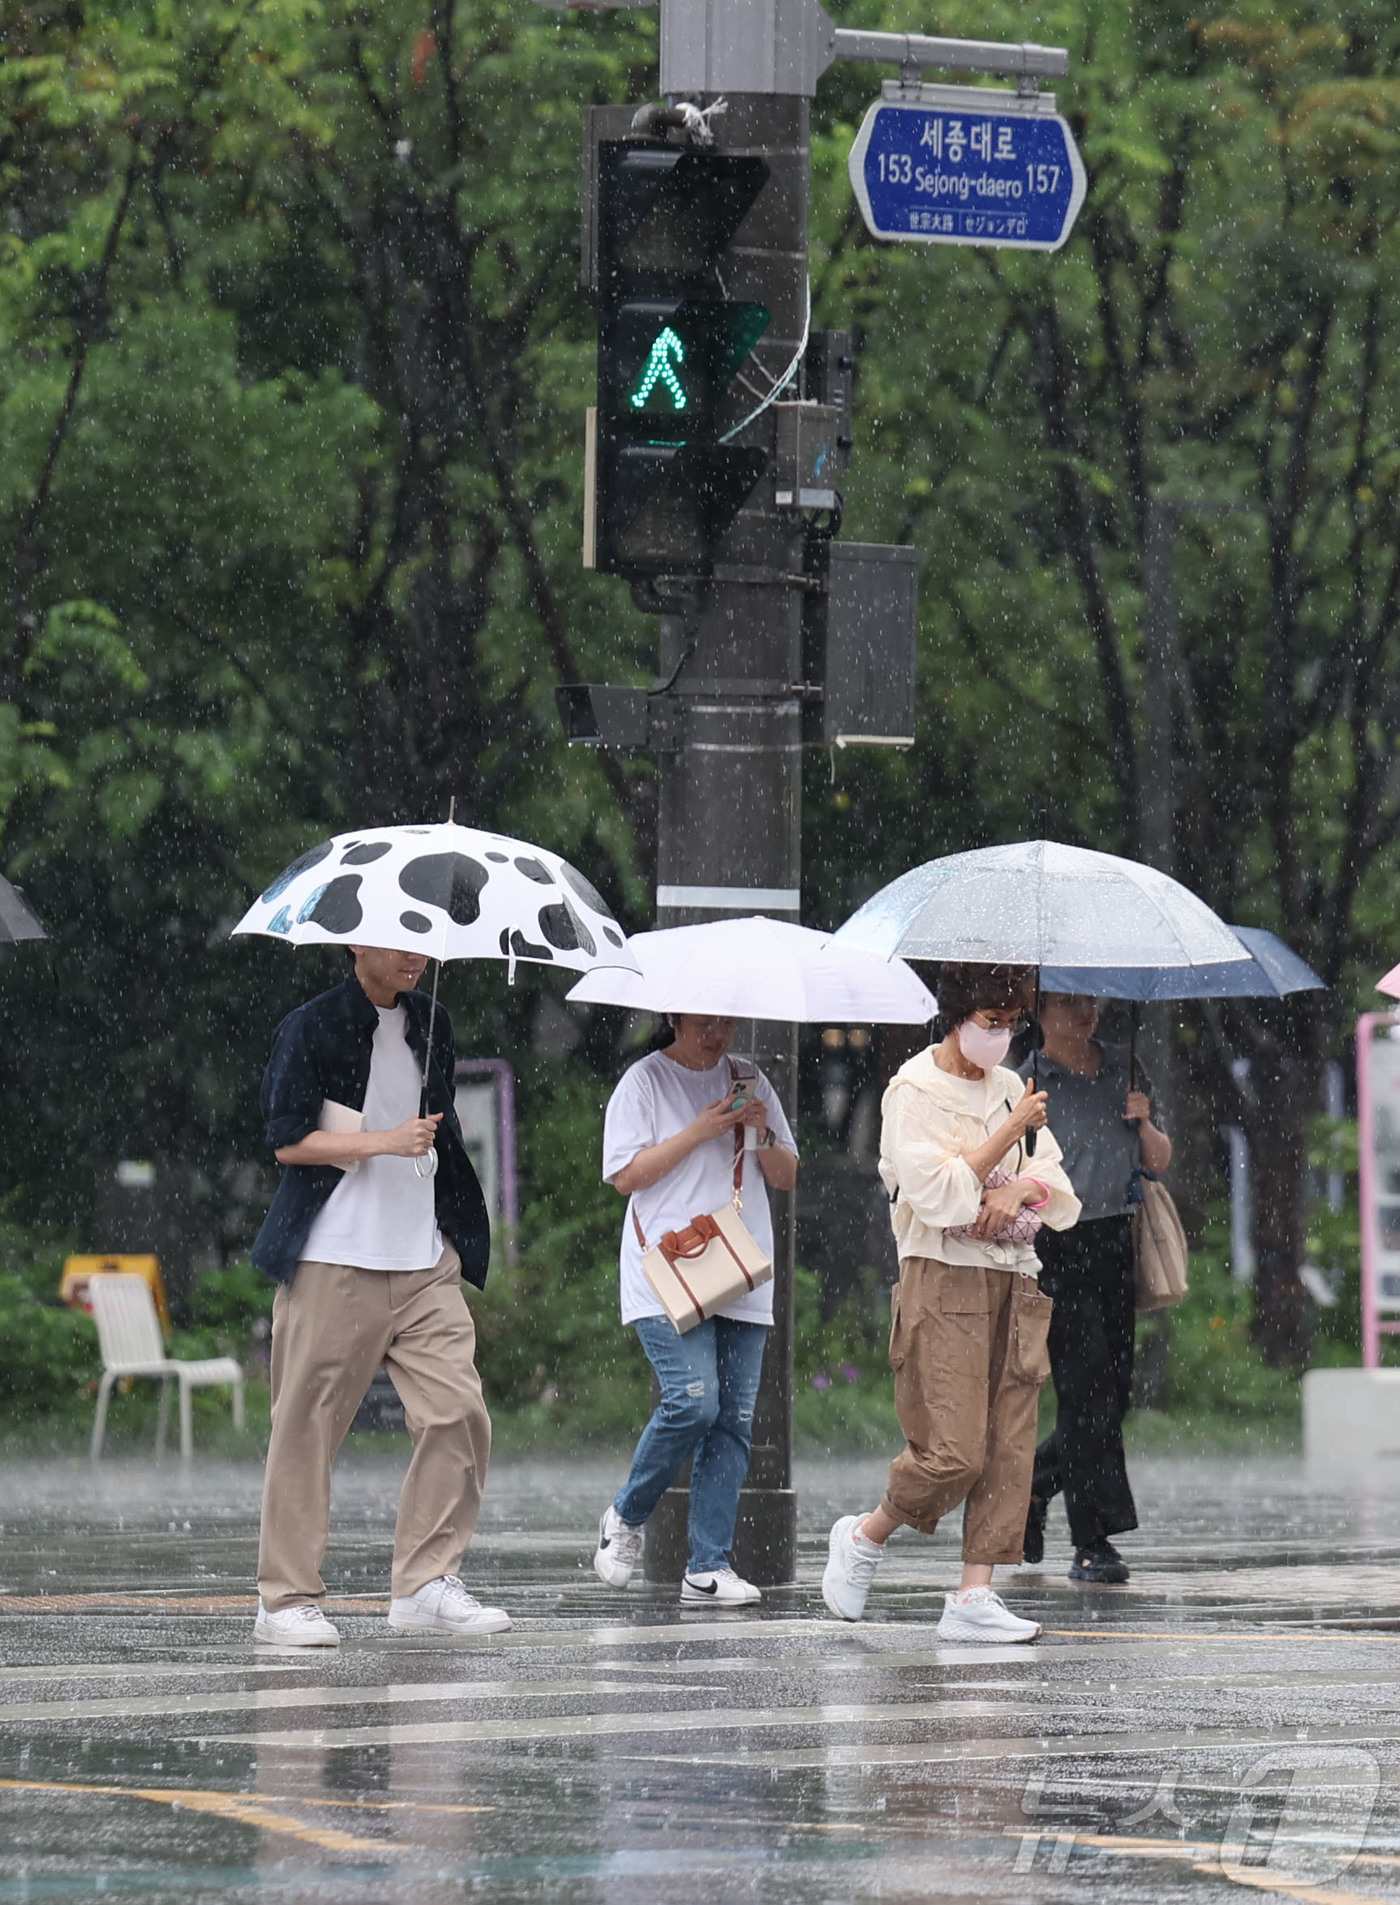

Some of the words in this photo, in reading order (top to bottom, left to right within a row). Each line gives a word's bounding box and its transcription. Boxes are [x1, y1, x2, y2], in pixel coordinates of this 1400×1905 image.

[919, 118, 1017, 163] 세종대로
[878, 153, 912, 184] 153
[915, 166, 1023, 200] Sejong-daero
[1026, 163, 1061, 194] 157
